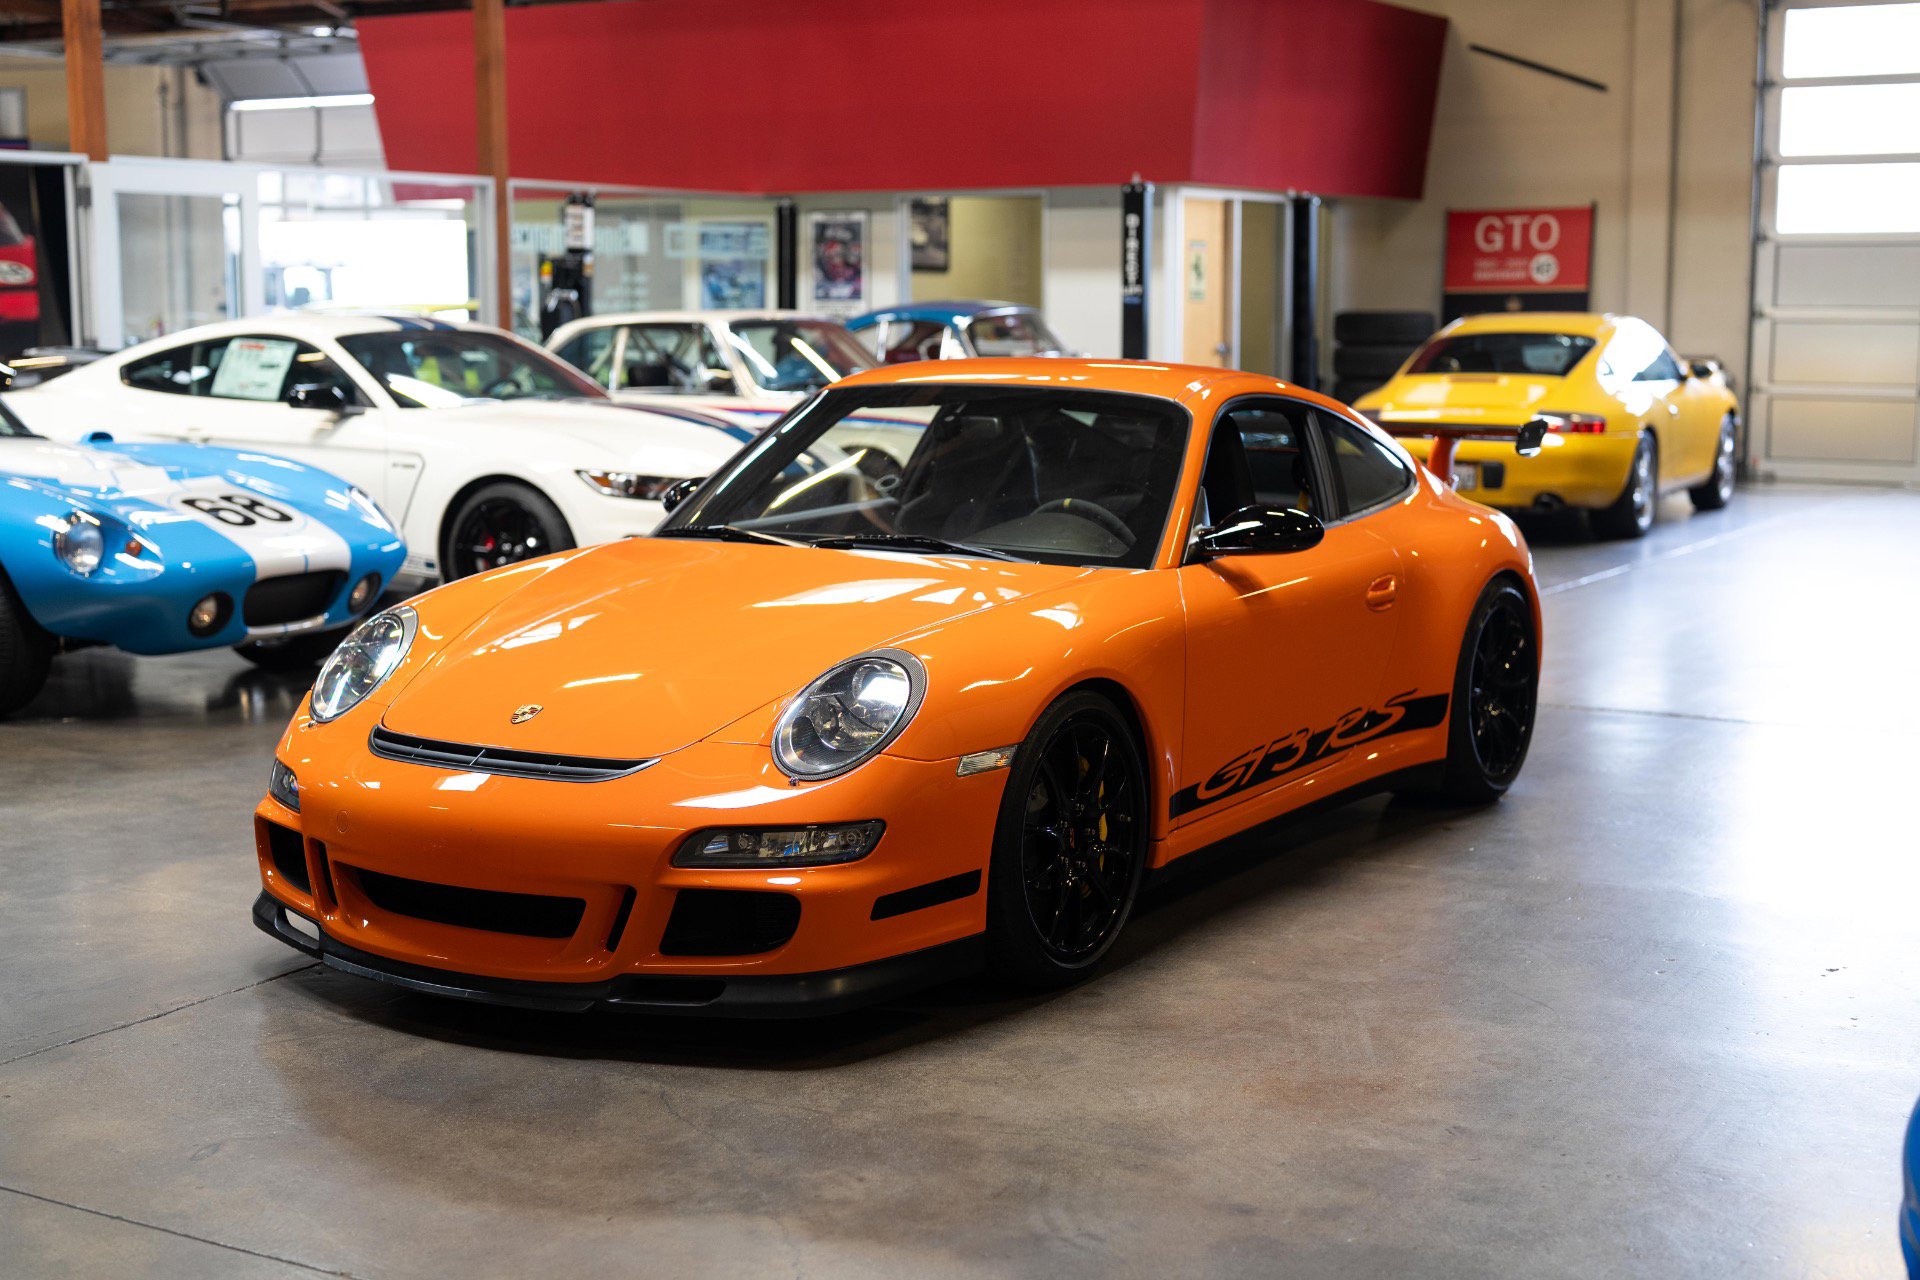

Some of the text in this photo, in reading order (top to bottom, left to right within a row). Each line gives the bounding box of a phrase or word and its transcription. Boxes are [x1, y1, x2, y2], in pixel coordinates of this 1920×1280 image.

[1474, 214, 1560, 252] GTO
[181, 495, 293, 526] 68
[1196, 687, 1419, 800] GT3 RS
